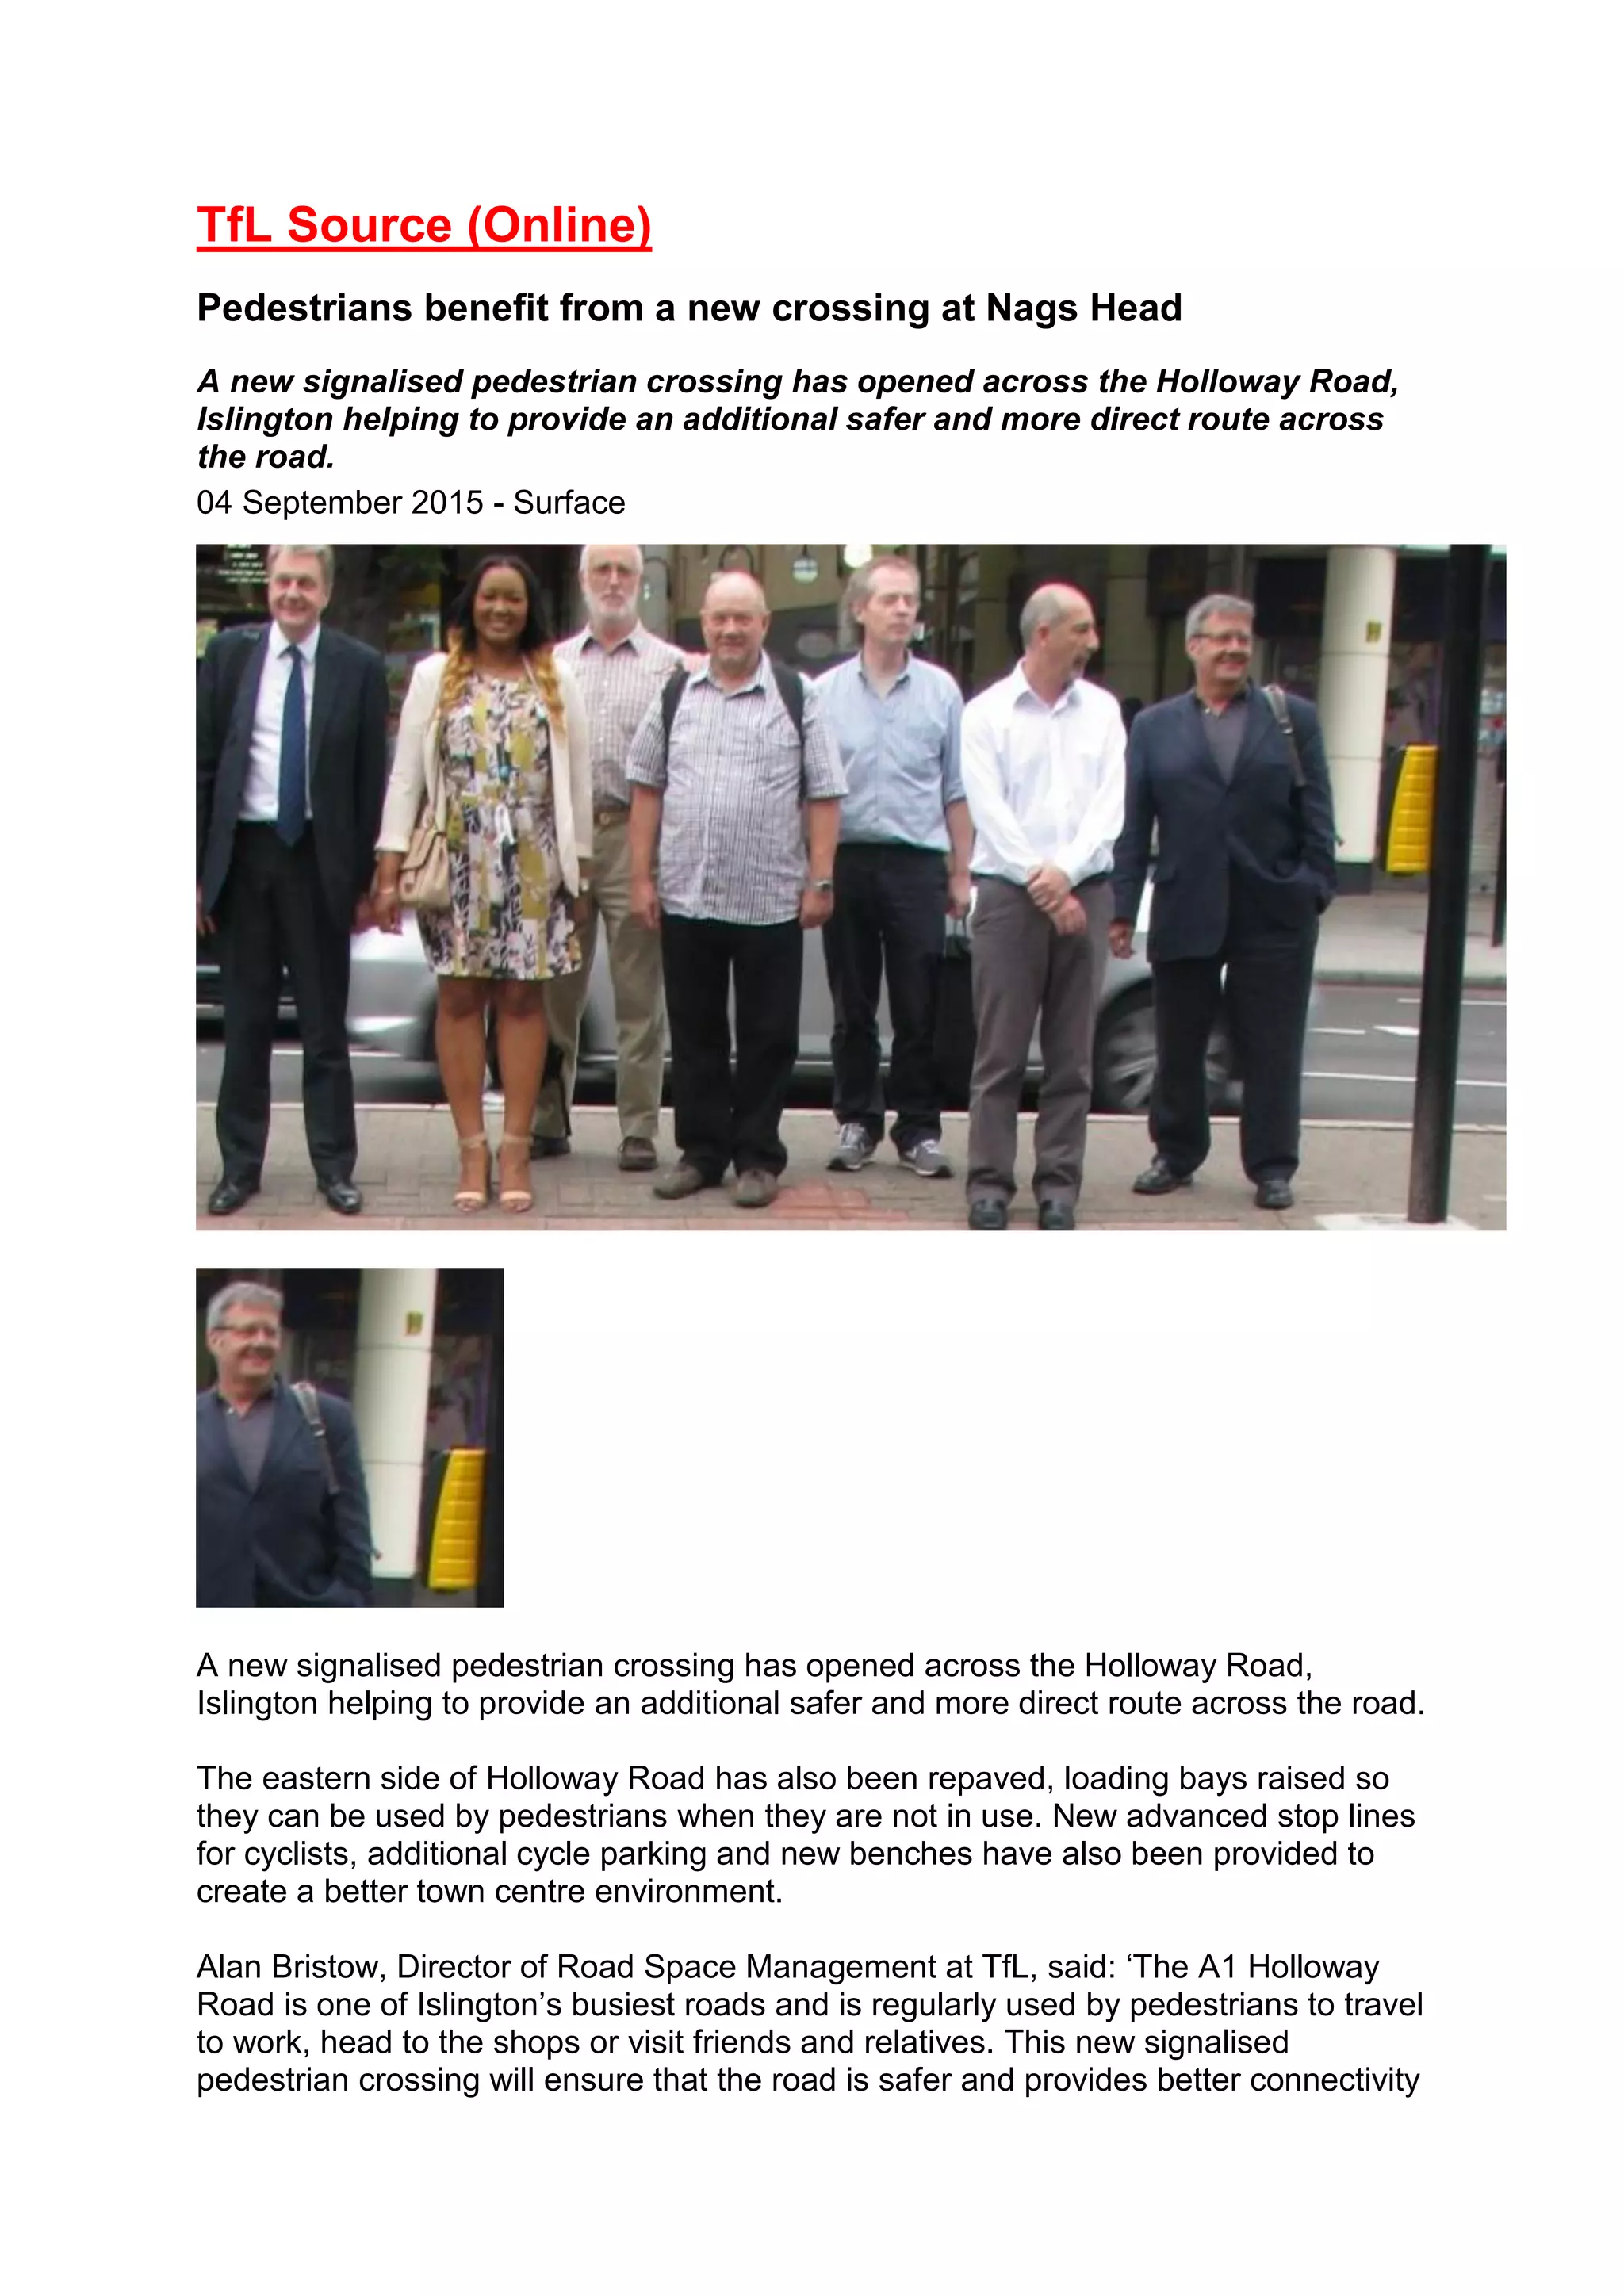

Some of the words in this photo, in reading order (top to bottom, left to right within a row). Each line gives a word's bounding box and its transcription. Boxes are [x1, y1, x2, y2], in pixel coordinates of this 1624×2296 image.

[197, 205, 272, 243] TfL
[288, 205, 452, 243] Source
[468, 205, 651, 246] (Online)
[198, 293, 412, 322] Pedestrians
[426, 292, 550, 322] benefit
[559, 292, 643, 322] from
[655, 300, 676, 322] a
[688, 300, 761, 322] new
[772, 293, 929, 330] crossing
[941, 293, 975, 322] at
[987, 293, 1078, 330] Nags
[1091, 293, 1182, 322] Head
[195, 368, 220, 393] A
[230, 374, 296, 393] new
[302, 368, 465, 400] signalised
[470, 368, 637, 400] pedestrian
[646, 368, 783, 400] crossing
[791, 368, 848, 394] has
[857, 368, 975, 400] opened
[982, 374, 1089, 394] across
[1099, 368, 1147, 394] the
[1156, 368, 1302, 400] Holloway
[1309, 368, 1398, 398] Road,
[197, 405, 333, 438] Islington
[343, 406, 460, 438] helping
[469, 407, 499, 431] to
[507, 406, 626, 438] provide
[635, 411, 673, 431] an
[683, 405, 839, 431] additional
[845, 405, 927, 431] safer
[933, 406, 994, 431] and
[1001, 411, 1081, 431] more
[1090, 406, 1182, 431] direct
[1187, 407, 1270, 431] route
[1279, 411, 1385, 431] across
[198, 443, 247, 469] the
[255, 443, 334, 469] road.
[197, 489, 232, 515] 04
[243, 488, 404, 521] September
[412, 489, 484, 515] 2015
[514, 488, 626, 515] Surface
[196, 1652, 219, 1677] A
[228, 1658, 289, 1678] new
[297, 1651, 441, 1684] signalised
[453, 1651, 603, 1684] pedestrian
[614, 1652, 734, 1684] crossing
[745, 1651, 797, 1678] has
[806, 1651, 914, 1684] opened
[925, 1658, 1021, 1678] across
[1029, 1651, 1075, 1678] the
[1086, 1651, 1217, 1684] Holloway
[1228, 1652, 1312, 1682] Road,
[199, 1689, 317, 1722] Islington
[329, 1689, 432, 1722] helping
[442, 1690, 469, 1715] to
[480, 1689, 585, 1721] provide
[595, 1696, 630, 1715] an
[641, 1689, 779, 1715] additional
[790, 1689, 864, 1715] safer
[871, 1689, 925, 1715] and
[936, 1696, 1009, 1715] more
[1019, 1689, 1099, 1715] direct
[1109, 1690, 1182, 1715] route
[1192, 1696, 1288, 1715] across
[1297, 1689, 1342, 1715] the
[1353, 1689, 1424, 1715] road.
[197, 1765, 252, 1790] The
[262, 1766, 370, 1790] eastern
[381, 1765, 440, 1790] side
[450, 1764, 478, 1790] of
[488, 1765, 619, 1797] Holloway
[629, 1765, 704, 1790] Road
[716, 1765, 768, 1790] has
[777, 1765, 837, 1790] also
[847, 1765, 917, 1790] been
[929, 1765, 1053, 1797] repaved,
[1065, 1765, 1169, 1797] loading
[1180, 1765, 1247, 1797] bays
[1258, 1765, 1345, 1790] raised
[1355, 1771, 1389, 1790] so
[196, 1802, 259, 1835] they
[268, 1808, 319, 1828] can
[331, 1802, 366, 1828] be
[376, 1802, 444, 1828] used
[456, 1802, 490, 1835] by
[500, 1802, 668, 1835] pedestrians
[676, 1802, 754, 1828] when
[764, 1802, 827, 1835] they
[836, 1808, 883, 1828] are
[893, 1804, 938, 1828] not
[948, 1802, 971, 1827] in
[982, 1808, 1041, 1828] use.
[1054, 1802, 1118, 1828] New
[1126, 1802, 1267, 1828] advanced
[1277, 1803, 1339, 1835] stop
[1350, 1802, 1415, 1828] lines
[196, 1839, 236, 1866] for
[244, 1840, 356, 1872] cyclists,
[367, 1840, 507, 1866] additional
[517, 1840, 590, 1873] cycle
[601, 1840, 706, 1873] parking
[717, 1840, 770, 1866] and
[782, 1846, 841, 1866] new
[850, 1840, 973, 1866] benches
[983, 1840, 1052, 1866] have
[1062, 1840, 1122, 1866] also
[1132, 1840, 1202, 1866] been
[1214, 1840, 1337, 1872] provided
[1347, 1841, 1375, 1866] to
[196, 1954, 261, 1979] Alan
[273, 1954, 385, 1983] Bristow,
[398, 1954, 512, 1979] Director
[520, 1953, 549, 1979] of
[558, 1954, 634, 1979] Road
[645, 1953, 737, 1985] Space
[747, 1954, 937, 1985] Management
[946, 1954, 974, 1979] at
[982, 1953, 1036, 1983] TfL,
[1048, 1954, 1115, 1979] said:
[1127, 1954, 1189, 1979] ‘The
[1197, 1954, 1233, 1979] A1
[1249, 1954, 1381, 1985] Holloway
[196, 2030, 224, 2054] to
[232, 2029, 309, 2058] work,
[321, 2029, 392, 2054] head
[402, 2030, 429, 2054] to
[438, 2029, 484, 2054] the
[493, 2029, 580, 2061] shops
[590, 2034, 620, 2054] or
[627, 2029, 684, 2054] visit
[692, 2028, 791, 2054] friends
[801, 2029, 854, 2054] and
[865, 2028, 993, 2054] relatives.
[1004, 2029, 1066, 2054] This
[1076, 2034, 1136, 2054] new
[1144, 2028, 1289, 2061] signalised
[197, 2066, 348, 2098] pedestrian
[359, 2066, 479, 2099] crossing
[489, 2066, 534, 2091] will
[544, 2072, 644, 2092] ensure
[653, 2066, 708, 2092] that
[717, 2066, 762, 2092] the
[772, 2066, 836, 2092] road
[848, 2066, 869, 2092] is
[879, 2066, 953, 2092] safer
[961, 2066, 1013, 2092] and
[1025, 2066, 1147, 2098] provides
[1158, 2066, 1242, 2092] better
[1251, 2066, 1421, 2099] connectivity
